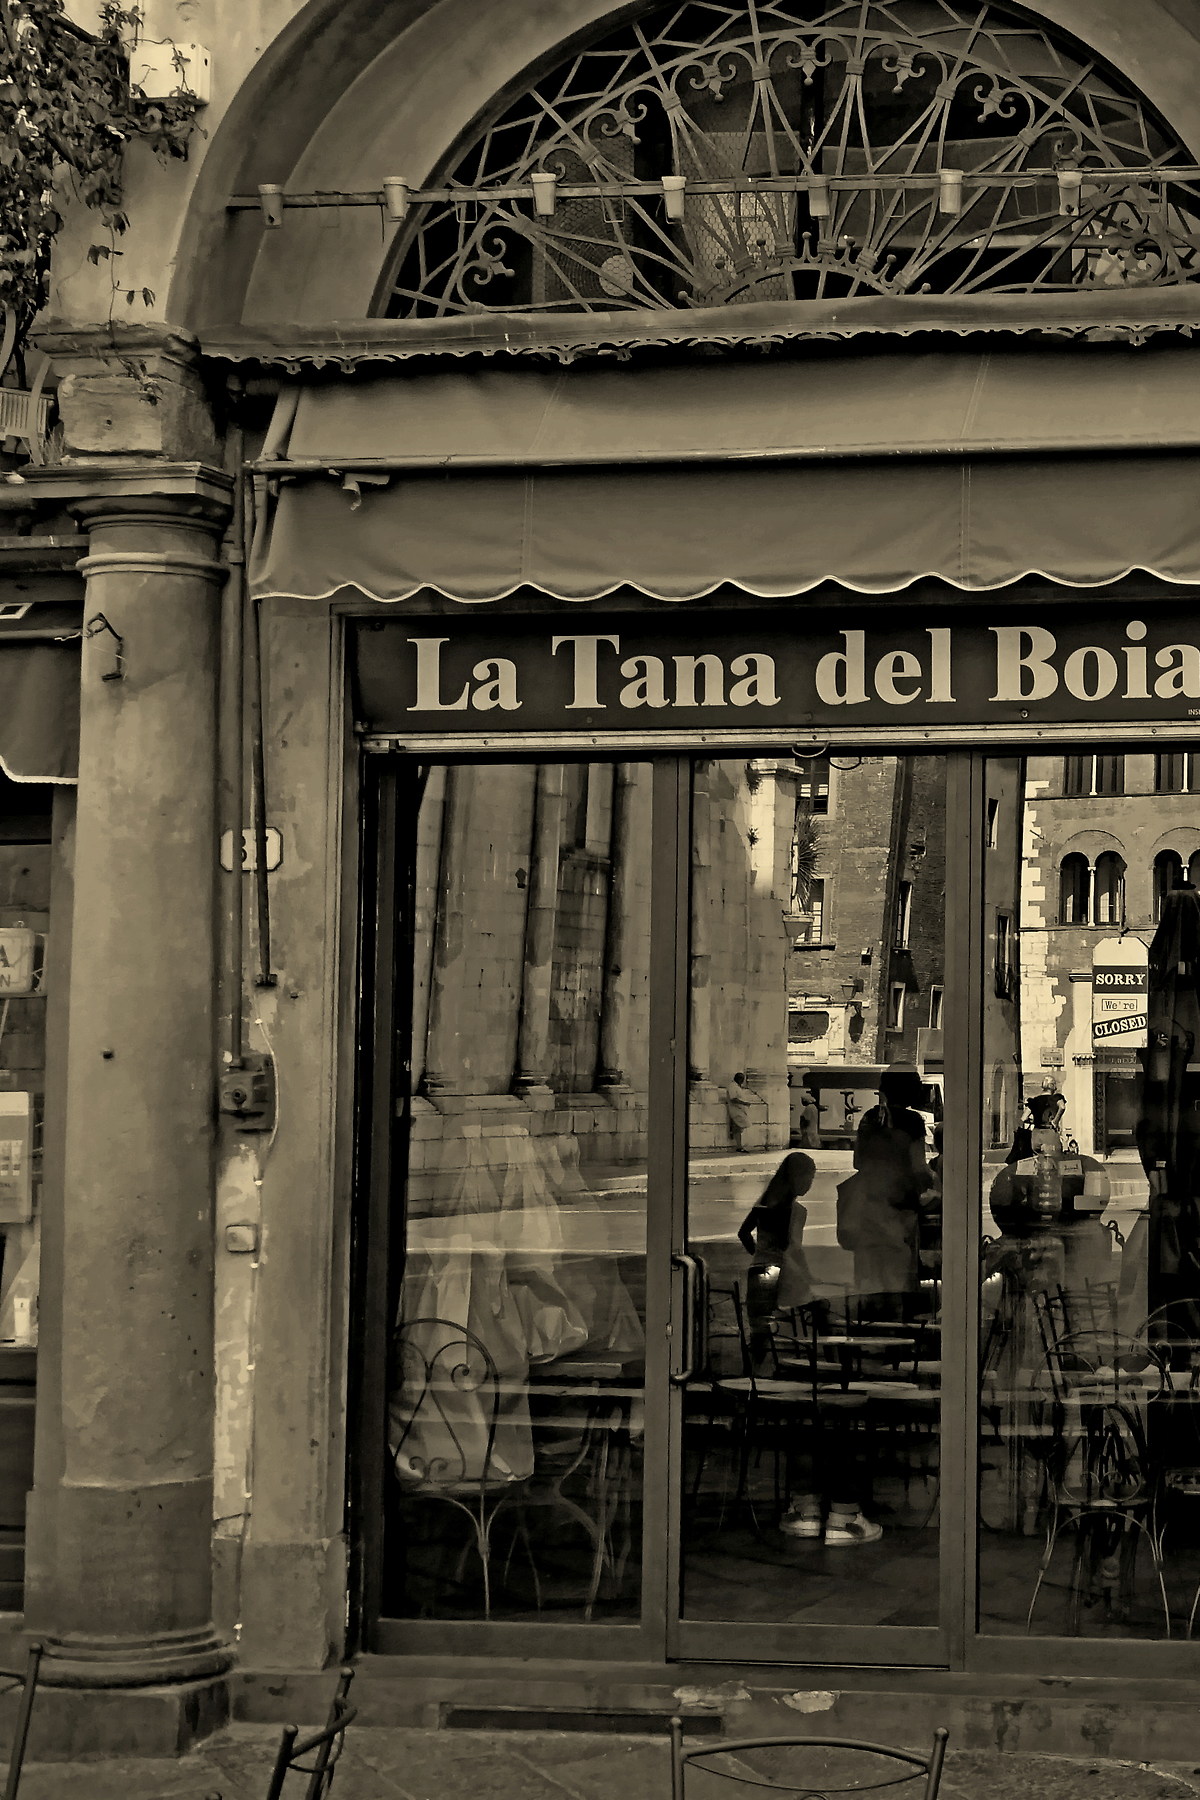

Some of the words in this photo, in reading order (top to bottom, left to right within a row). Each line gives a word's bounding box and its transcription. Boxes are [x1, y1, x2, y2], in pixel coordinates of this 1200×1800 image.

[406, 638, 523, 712] La
[551, 635, 782, 709] Tana
[815, 628, 957, 706] del
[1095, 973, 1146, 985] SORRY
[1104, 1001, 1135, 1010] We're
[1094, 1015, 1147, 1036] CLOSED
